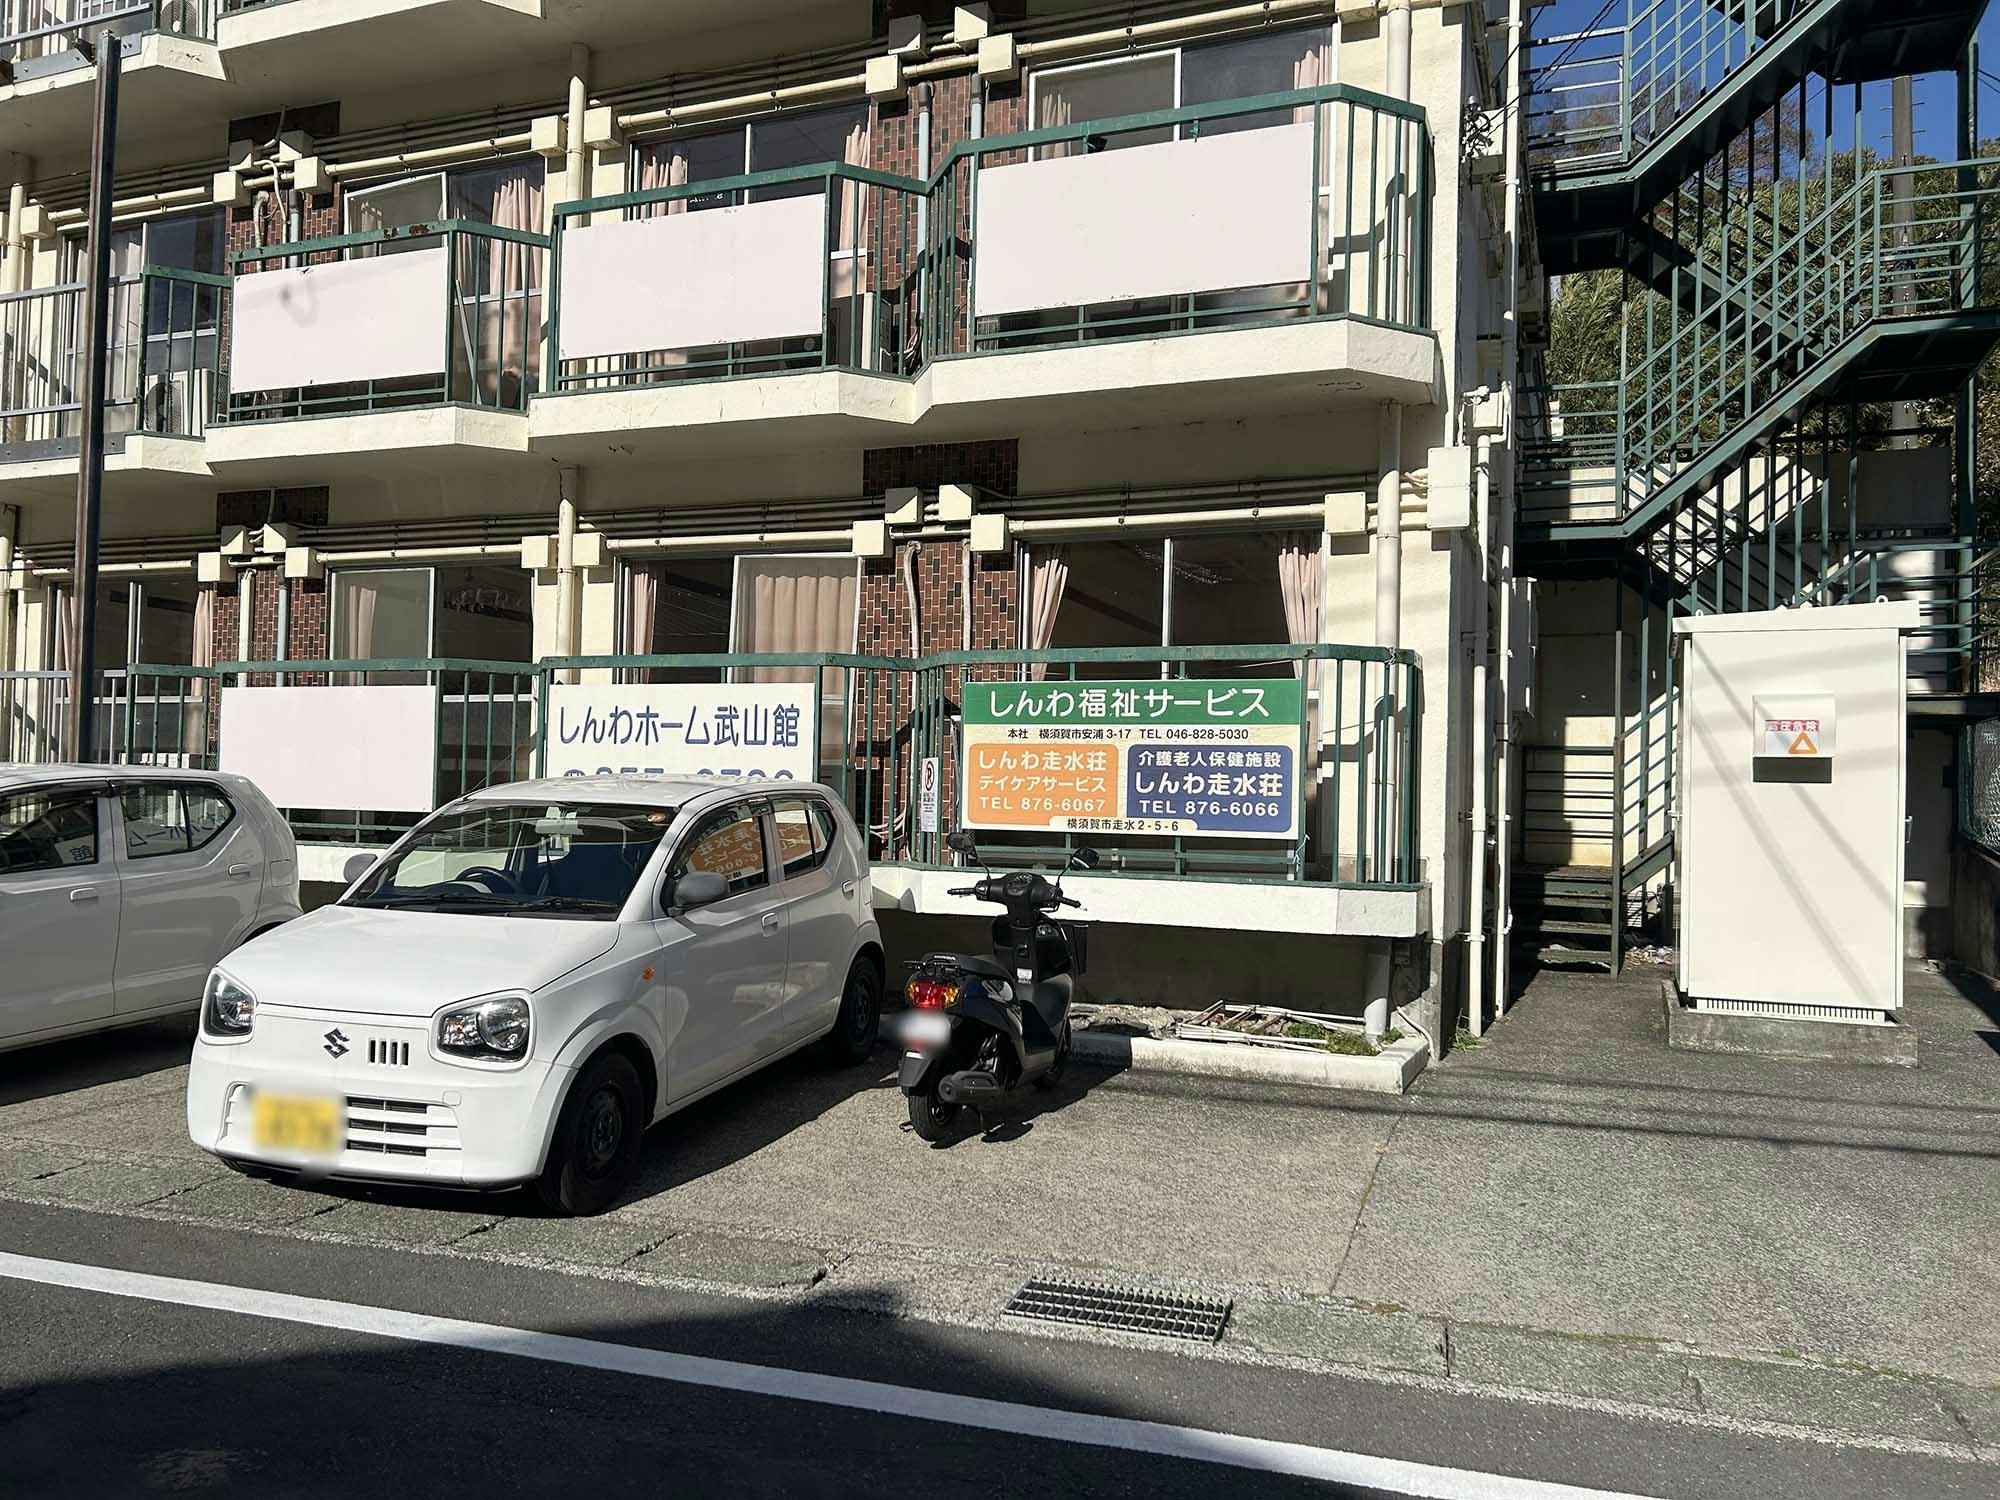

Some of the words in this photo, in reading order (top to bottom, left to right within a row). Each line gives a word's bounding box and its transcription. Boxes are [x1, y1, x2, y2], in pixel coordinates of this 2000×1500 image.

[989, 687, 1271, 719] しんわ福祉サービス
[559, 703, 801, 748] しんわホーム武山館
[1007, 728, 1029, 740] 本社
[1139, 728, 1163, 740] TEL
[1165, 728, 1250, 740] 046-828-5030
[978, 750, 1108, 772] しんわ走水荘
[1138, 750, 1282, 768] 介護老人保健施設
[978, 774, 1107, 793] デイケアサービス
[1134, 771, 1284, 797] しんわ走水荘
[978, 796, 1014, 810] TEL
[1020, 797, 1106, 812] 876-6067
[1138, 799, 1178, 814] TEL
[1184, 800, 1280, 817] 876-6066
